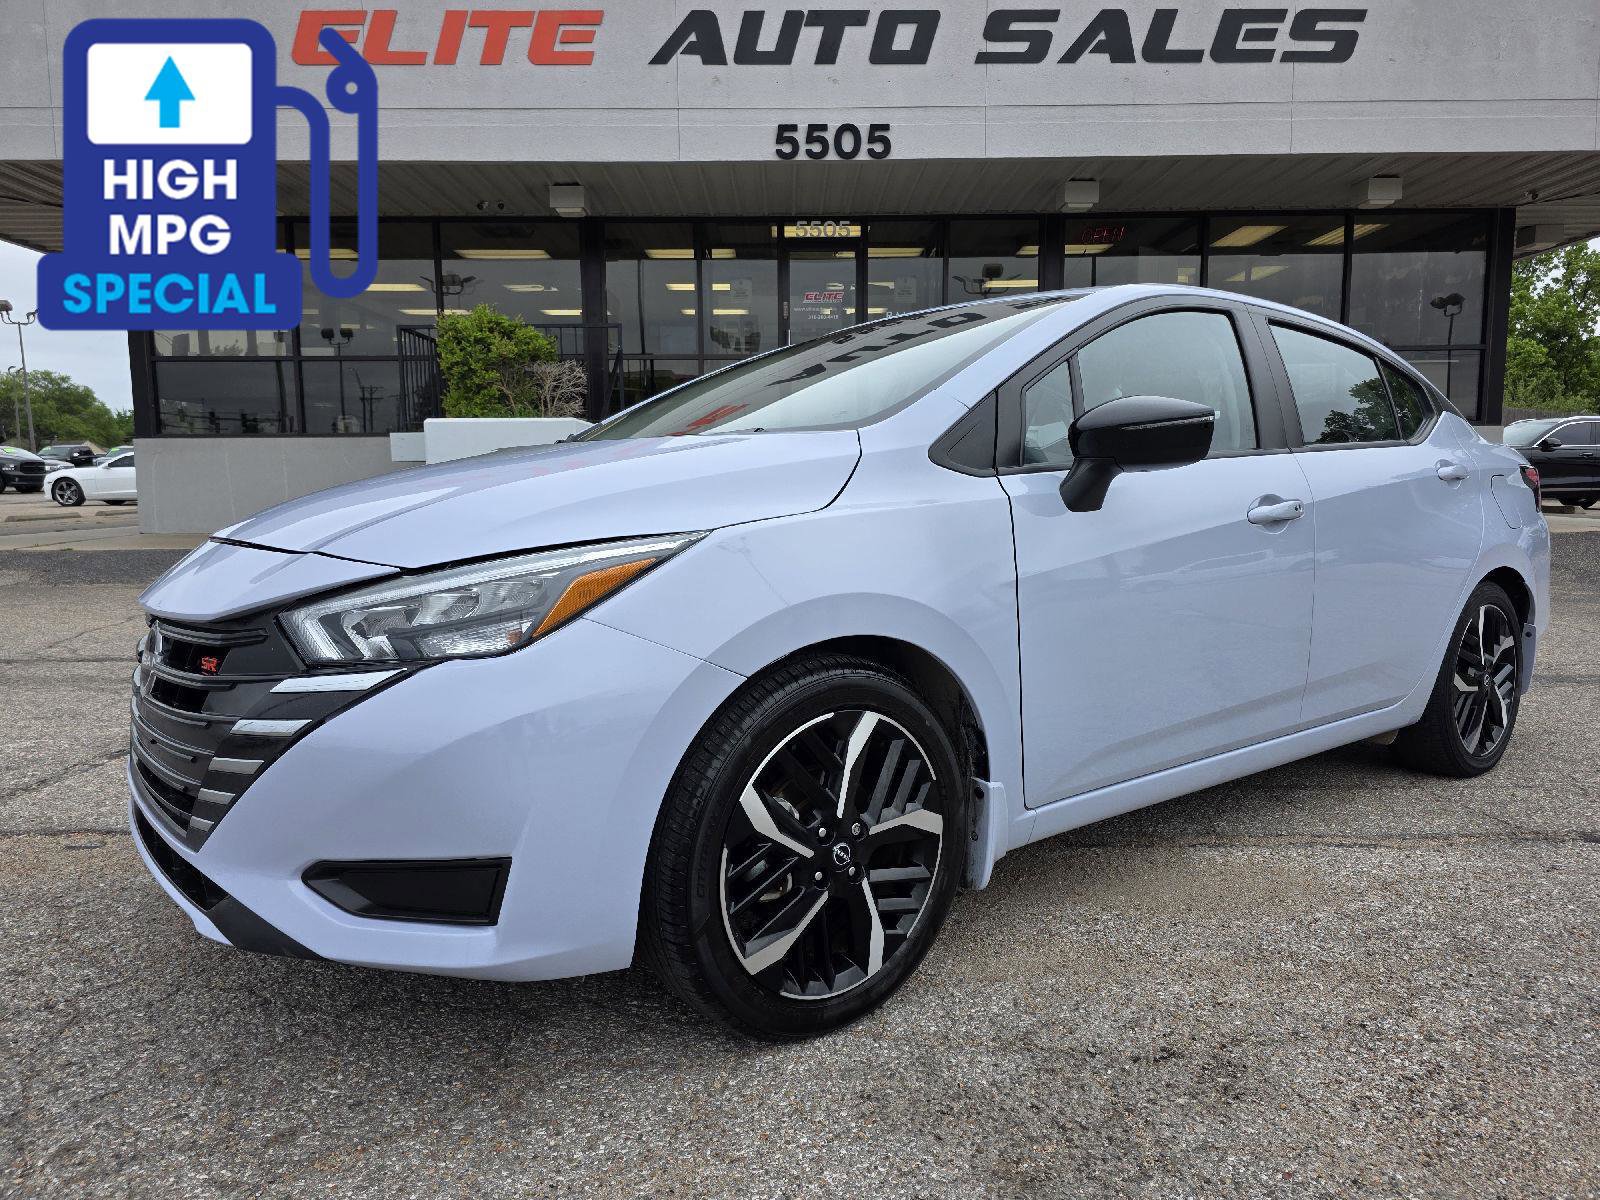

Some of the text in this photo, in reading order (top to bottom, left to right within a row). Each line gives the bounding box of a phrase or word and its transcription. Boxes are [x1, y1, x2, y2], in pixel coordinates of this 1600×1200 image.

[291, 8, 1368, 65] ELITE AUTO SALES
[775, 123, 892, 160] 5505
[795, 220, 851, 237] 5505
[803, 291, 844, 301] ELITE
[201, 656, 218, 672] SR
